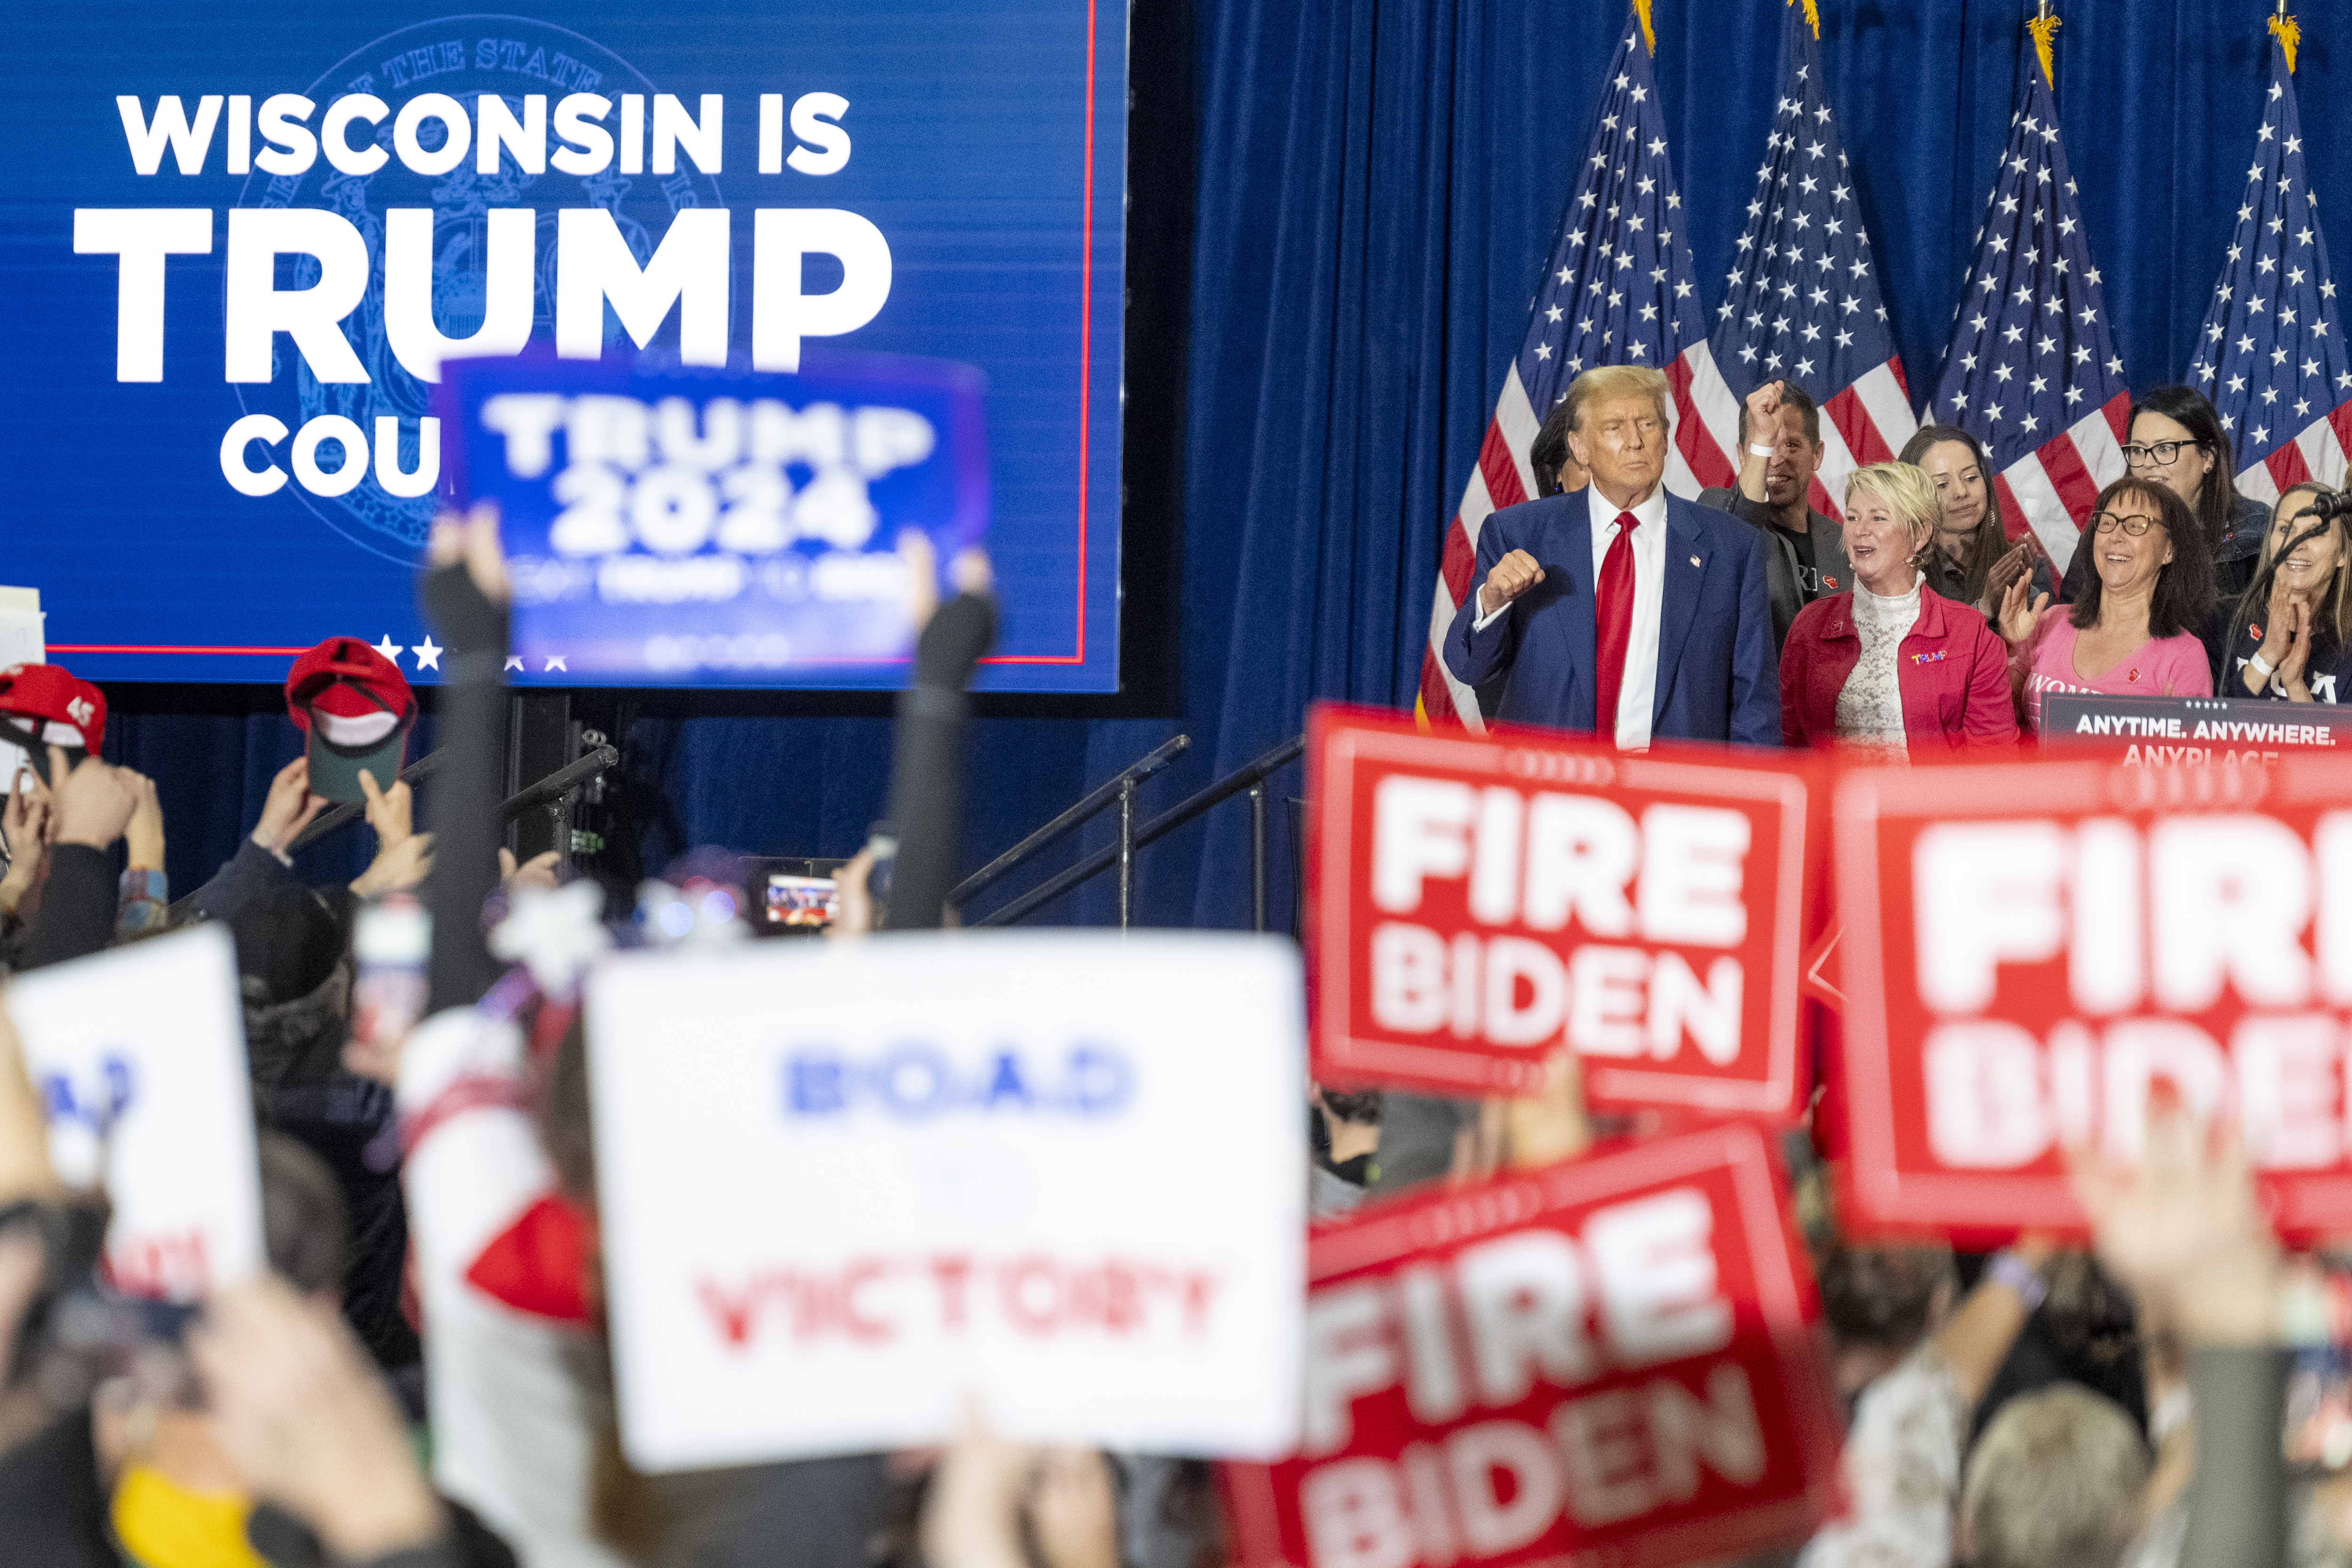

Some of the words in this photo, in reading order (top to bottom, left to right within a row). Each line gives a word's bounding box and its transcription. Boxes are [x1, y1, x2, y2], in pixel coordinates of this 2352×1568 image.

[117, 93, 723, 176] WISCONSIN
[758, 92, 851, 175] IS
[380, 40, 466, 89] THE
[475, 38, 603, 92] STATE
[73, 208, 892, 383] TRUMP
[220, 414, 441, 497] COU
[482, 394, 935, 480] TRUMP
[549, 466, 876, 555] 2024
[2075, 714, 2187, 739] ANYTIME.
[2193, 720, 2336, 746] ANYWHERE.
[1371, 774, 1751, 948] FIRE
[1914, 809, 2352, 1014] FIR
[1371, 920, 1745, 1066] BIDEN
[1923, 1015, 2352, 1170] BIDE
[1307, 1187, 1736, 1457] FIRE
[1298, 1363, 1766, 1568] BIDEN
